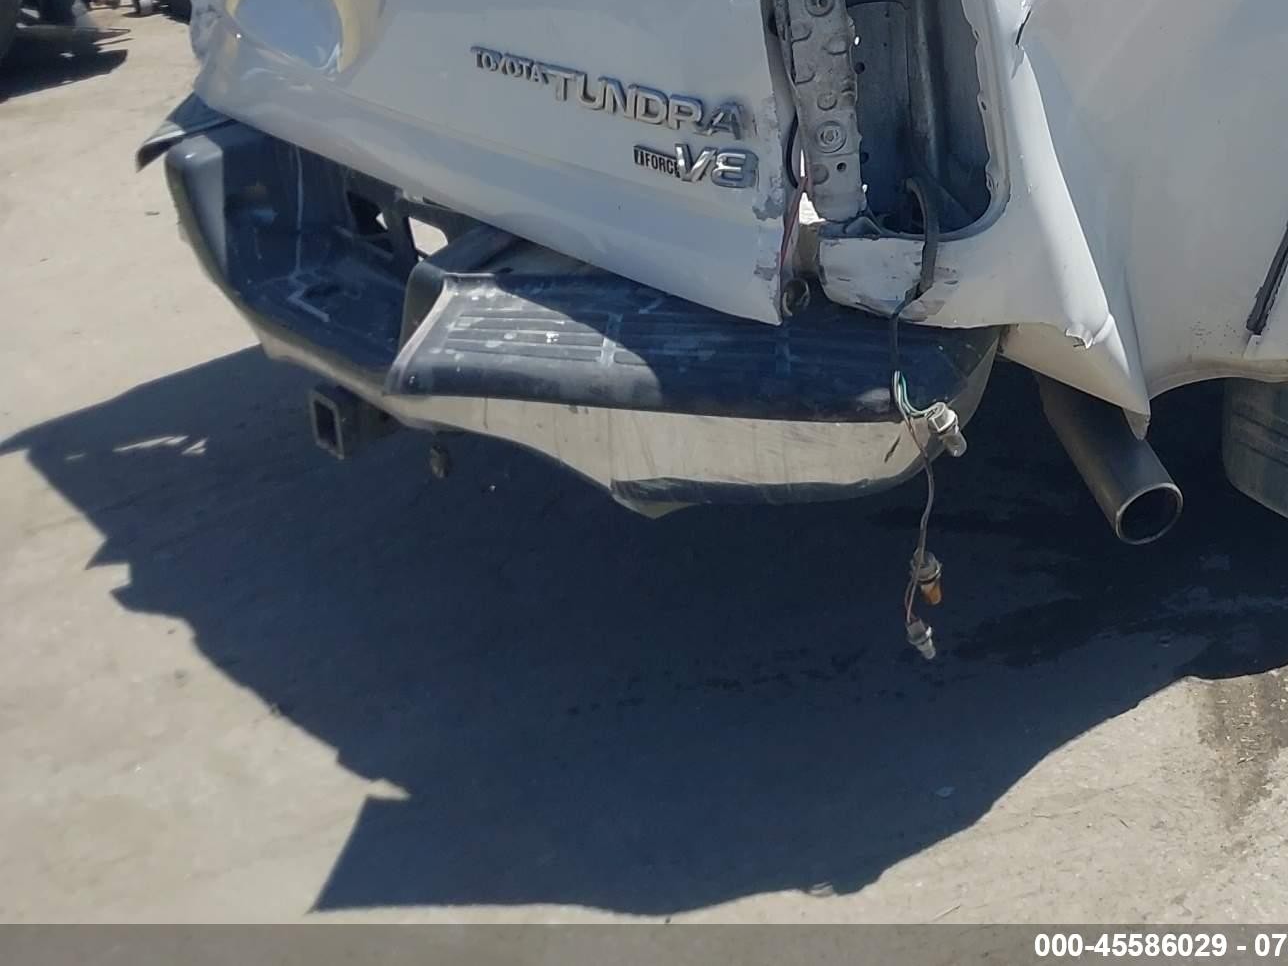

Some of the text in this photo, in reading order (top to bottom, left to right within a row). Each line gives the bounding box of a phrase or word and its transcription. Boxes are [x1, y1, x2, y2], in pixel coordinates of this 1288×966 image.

[471, 46, 744, 140] TOYOTA TUNDRA
[674, 143, 759, 189] V8
